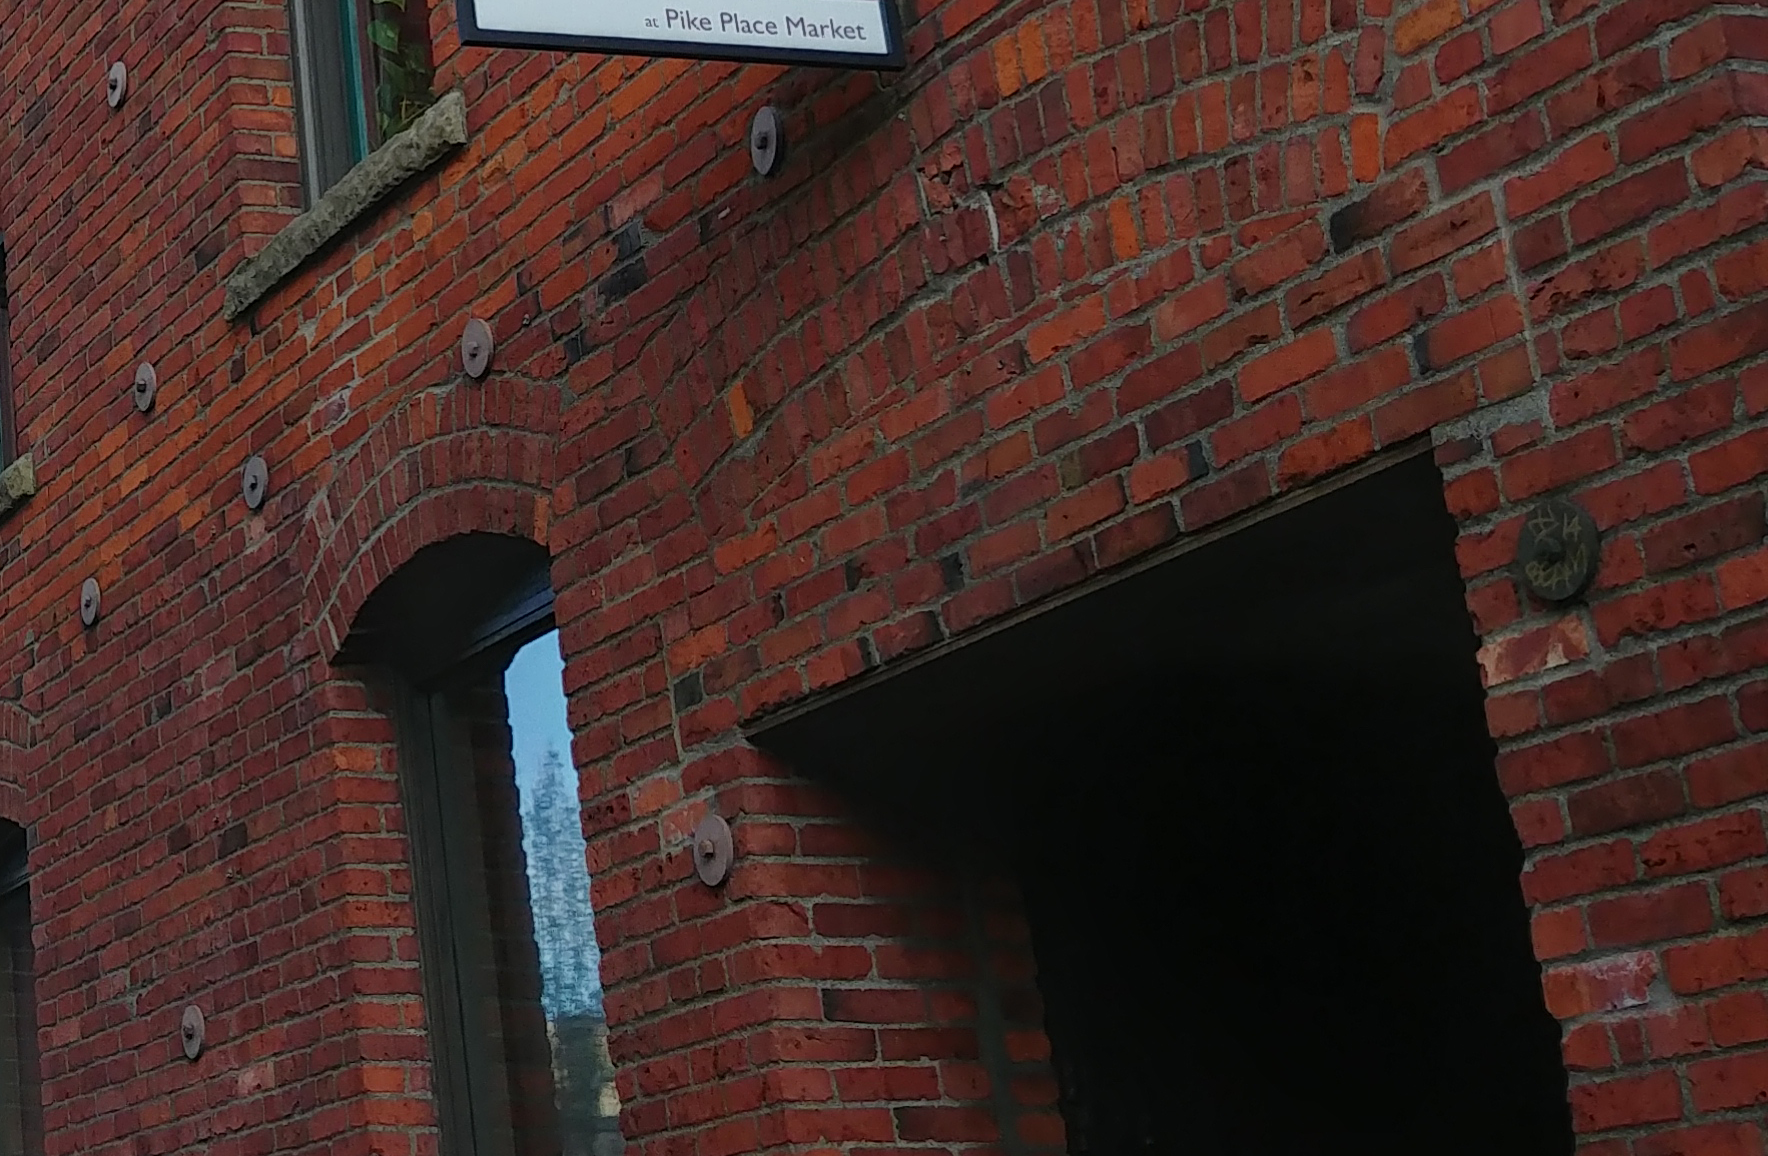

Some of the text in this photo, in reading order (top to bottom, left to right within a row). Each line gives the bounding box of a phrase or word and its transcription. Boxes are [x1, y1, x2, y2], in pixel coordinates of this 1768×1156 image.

[644, 8, 867, 40] at Pike Place Market
